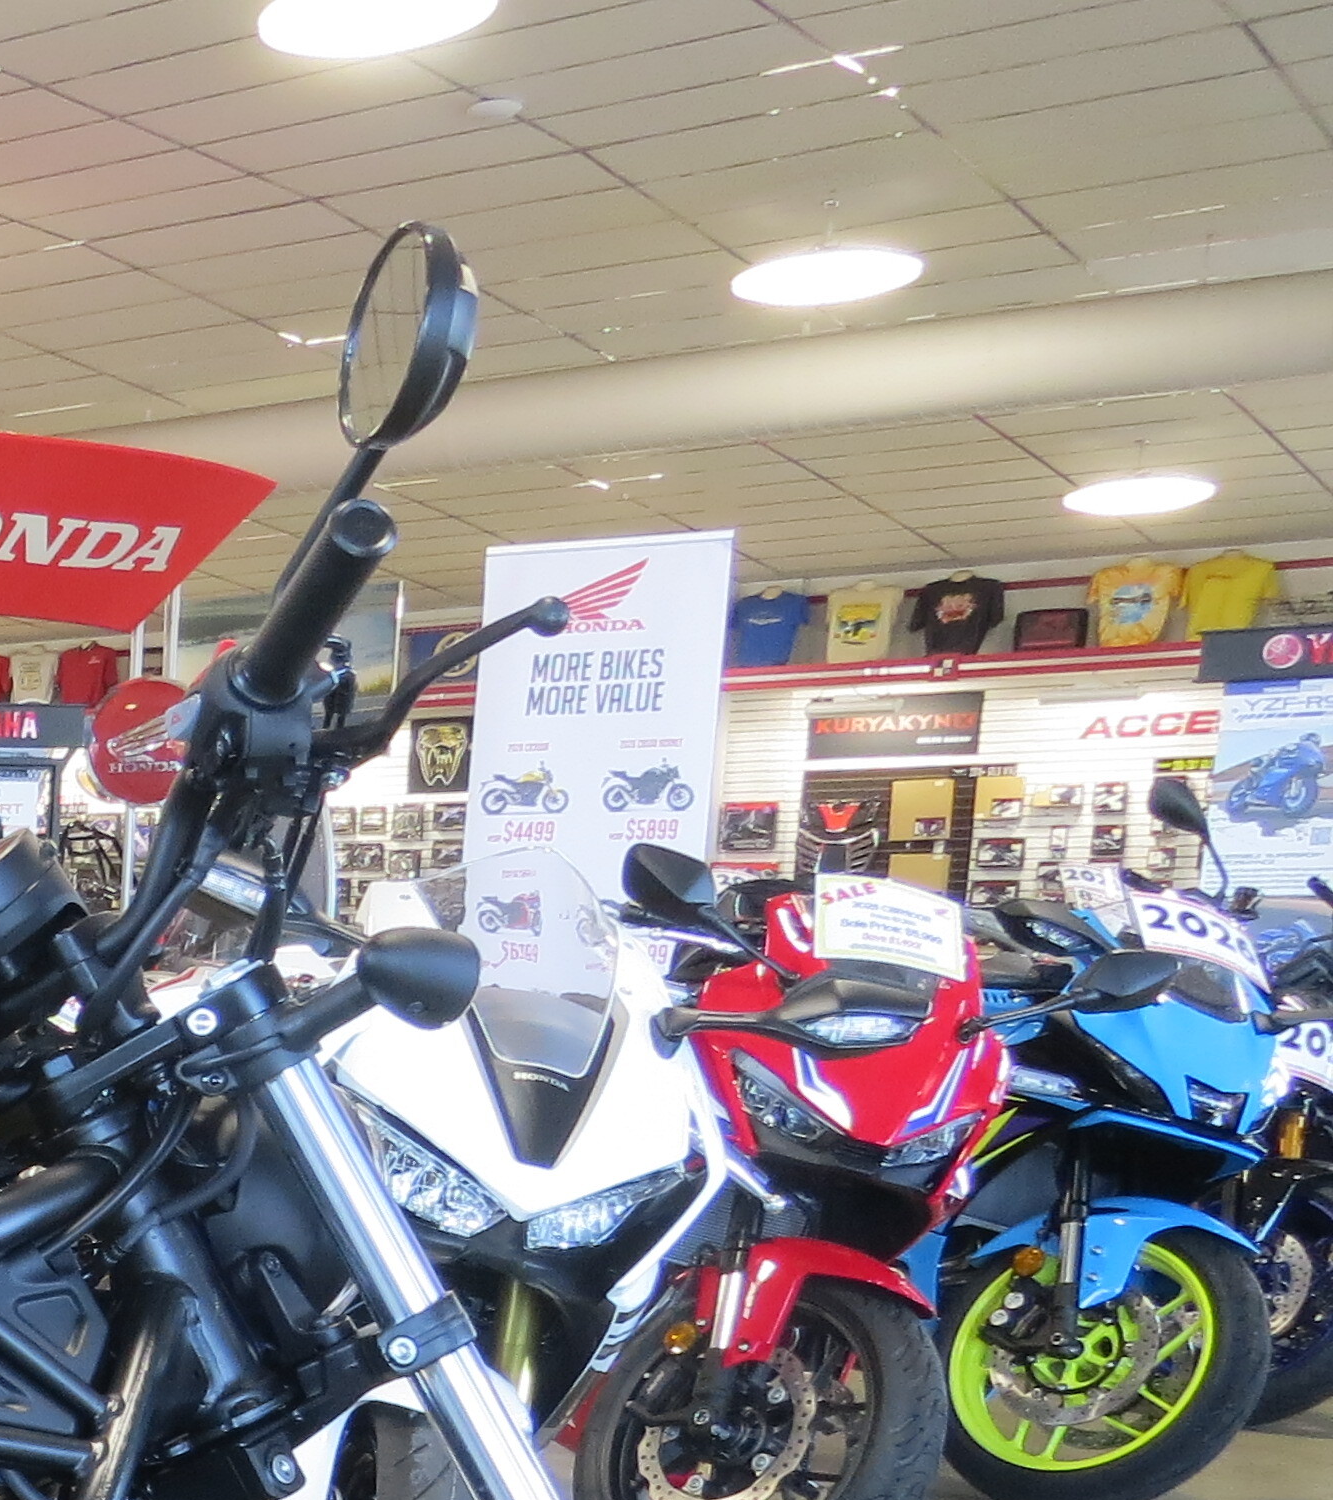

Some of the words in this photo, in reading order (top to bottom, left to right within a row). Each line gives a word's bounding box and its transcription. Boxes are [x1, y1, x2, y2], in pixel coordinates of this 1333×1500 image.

[530, 652, 594, 683] MORE
[599, 649, 665, 681] BIKES
[524, 685, 589, 716] MORE
[595, 682, 666, 714] VALUE
[107, 760, 183, 773] HONDA
[503, 821, 556, 843] $4499
[626, 818, 679, 840] $5899
[820, 881, 877, 905] SALE
[1142, 903, 1257, 966] 2026
